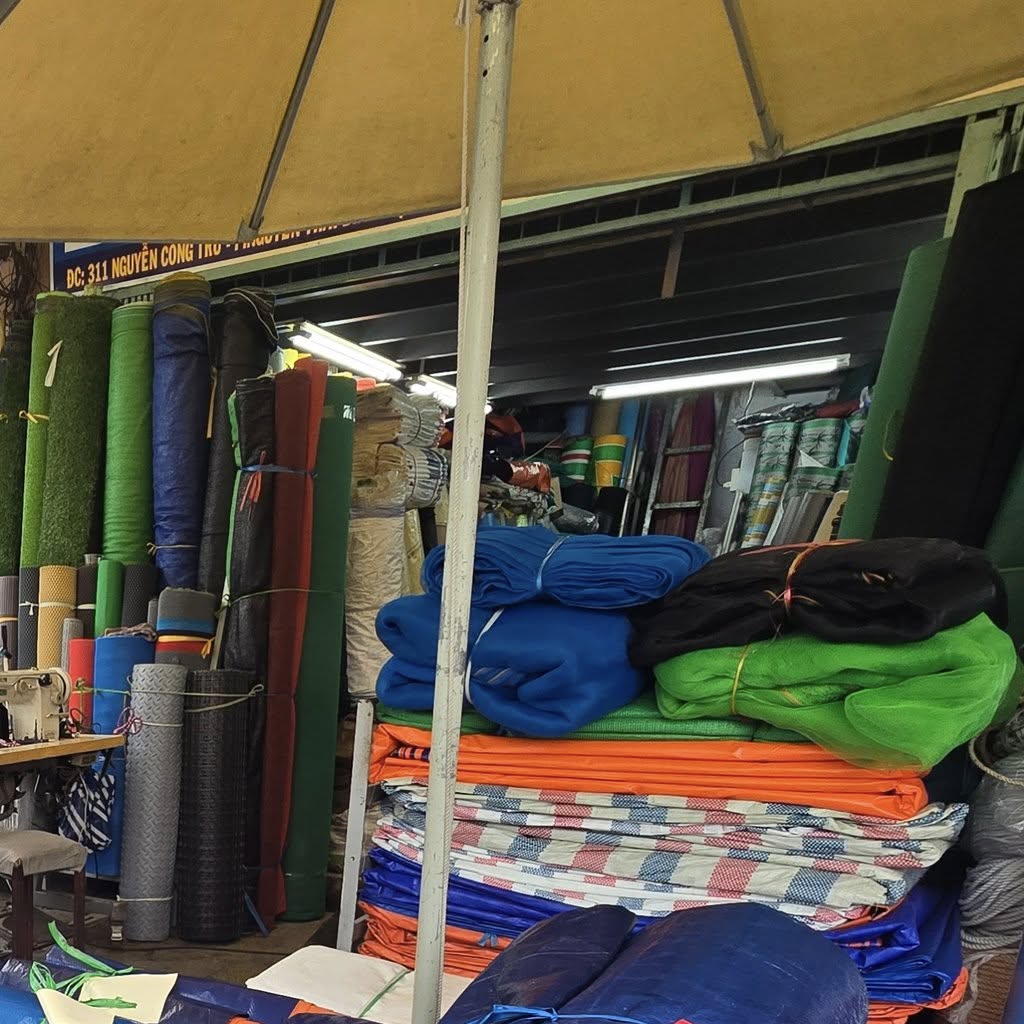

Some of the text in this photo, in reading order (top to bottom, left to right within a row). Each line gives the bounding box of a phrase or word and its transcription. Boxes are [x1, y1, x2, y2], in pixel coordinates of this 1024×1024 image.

[66, 267, 85, 289] ĐC:
[88, 260, 108, 283] 311
[111, 242, 157, 279] NGUYỄN
